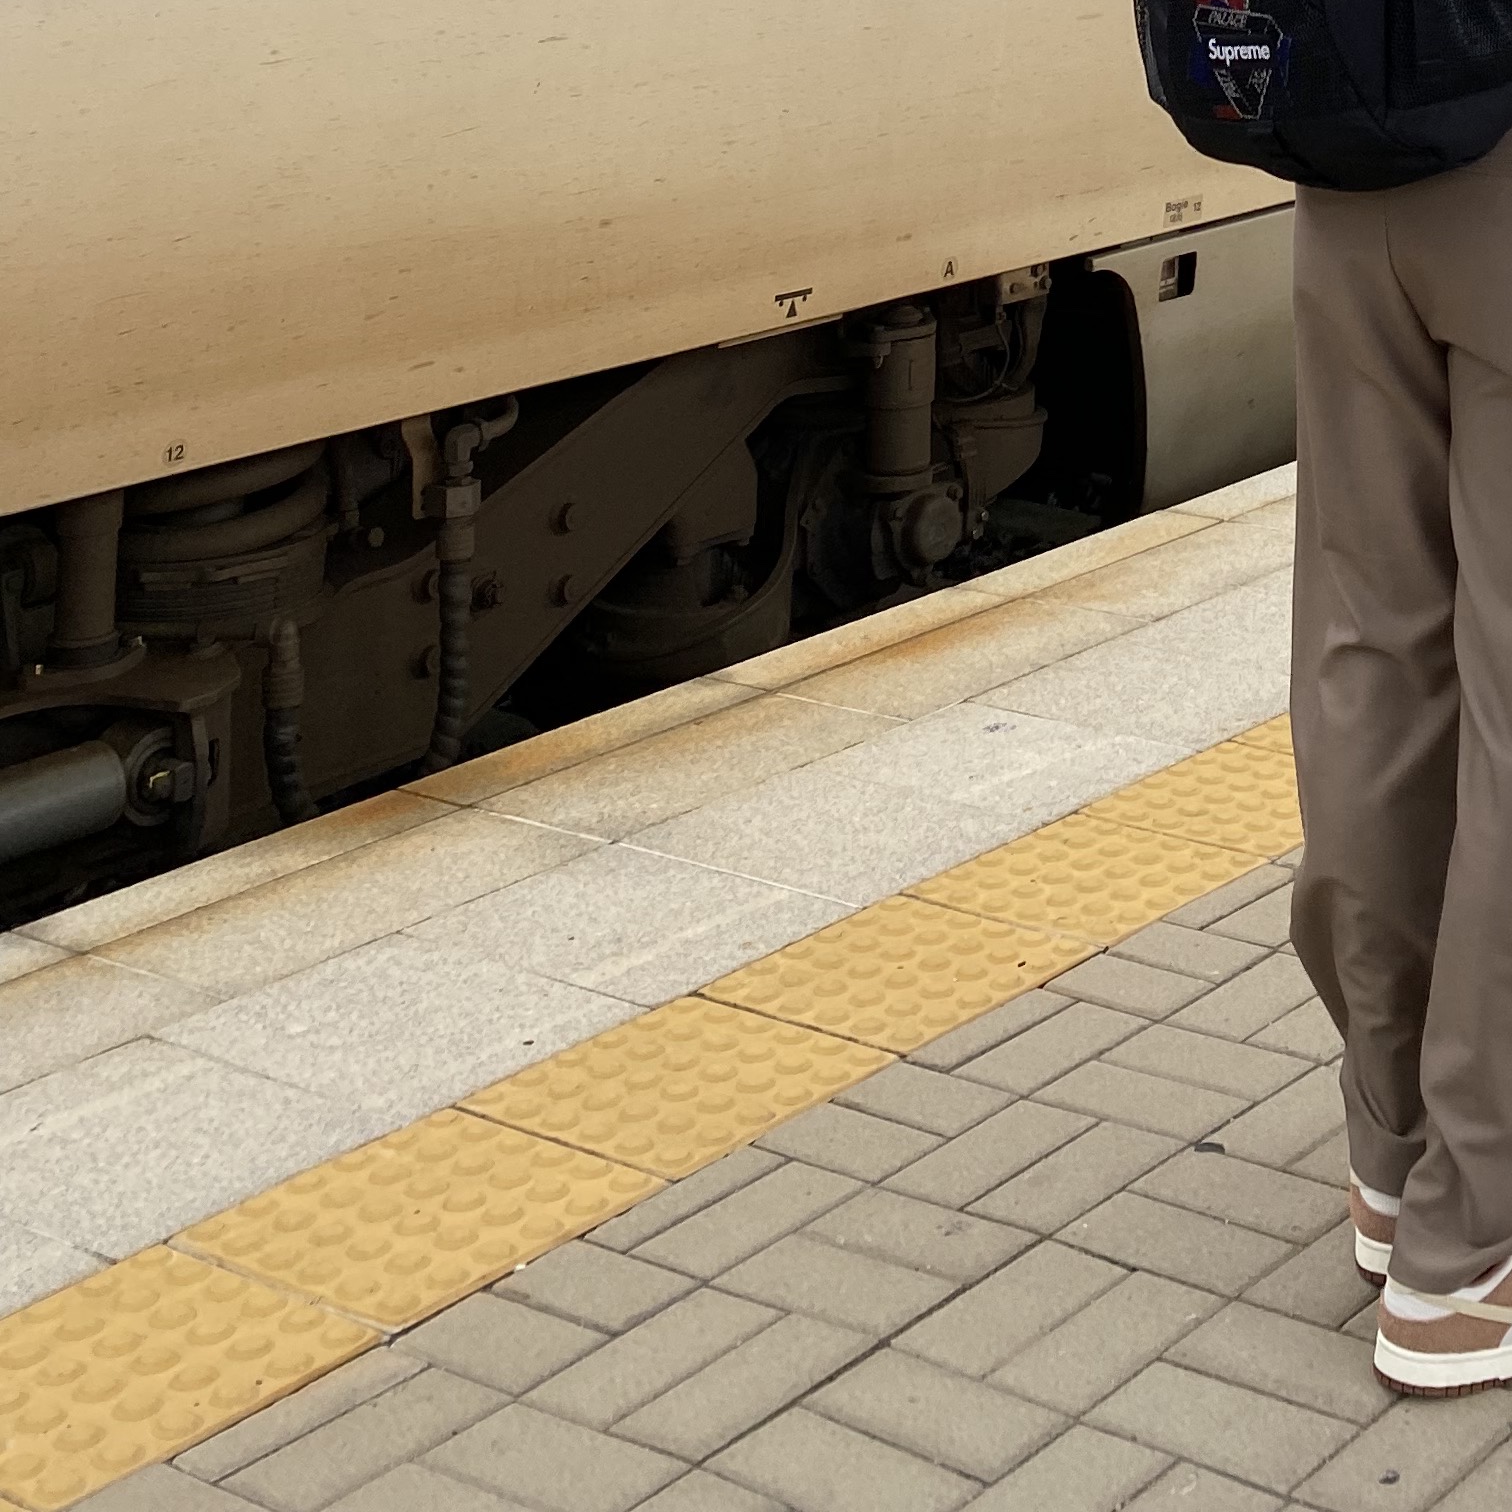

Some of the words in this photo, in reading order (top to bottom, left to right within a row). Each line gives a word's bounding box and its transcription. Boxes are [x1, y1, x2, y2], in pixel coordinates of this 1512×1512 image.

[1208, 37, 1271, 68] Supreme
[943, 260, 955, 278] A
[165, 444, 185, 463] 12
